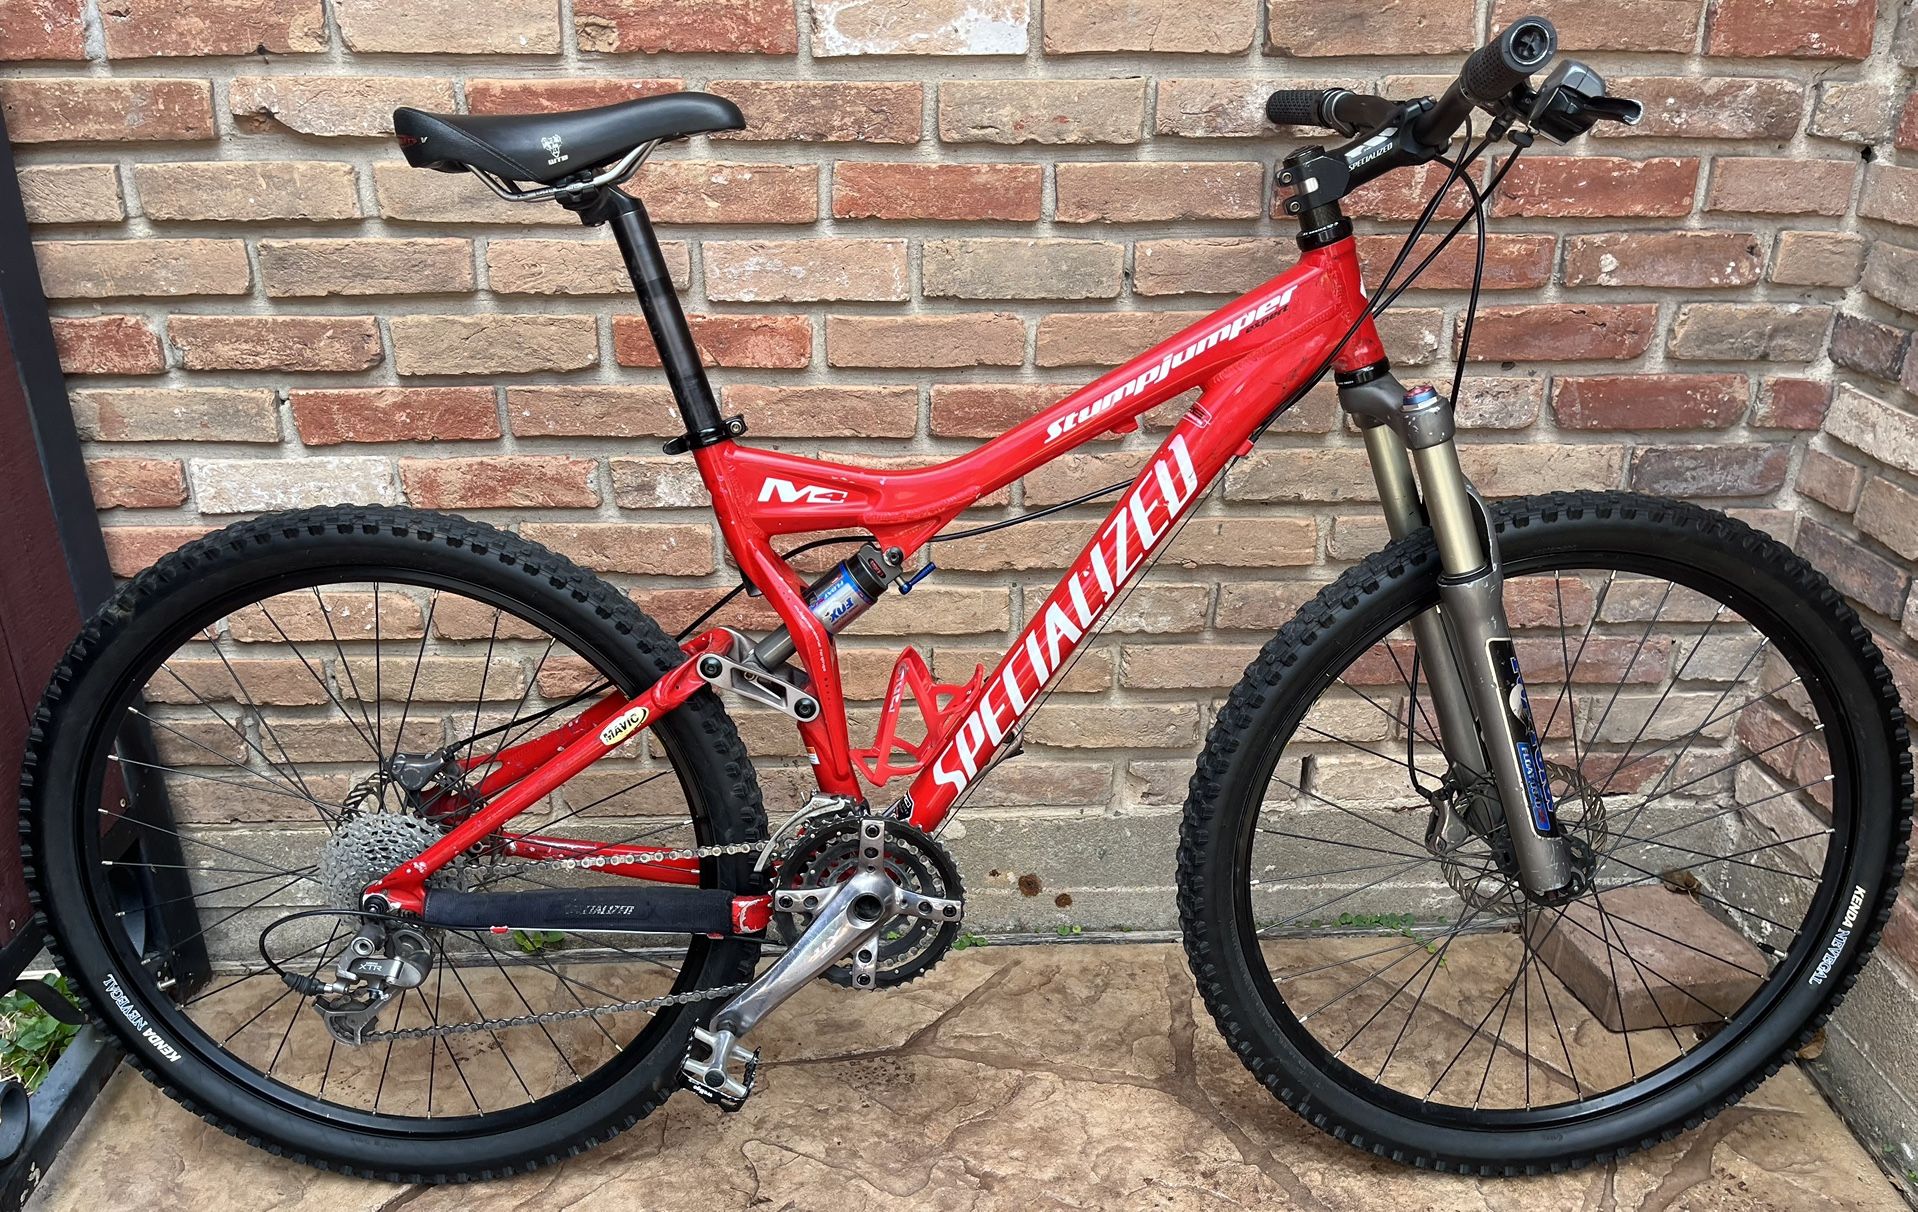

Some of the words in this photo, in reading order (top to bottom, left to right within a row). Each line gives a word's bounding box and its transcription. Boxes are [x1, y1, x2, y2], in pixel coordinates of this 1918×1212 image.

[548, 154, 569, 166] WTB
[1348, 142, 1393, 171] SPECIALIZED
[1246, 304, 1288, 334] expert
[1044, 285, 1297, 443] Stumpjumper
[830, 597, 854, 623] FOX
[933, 433, 1198, 803] SPECIALIZED
[603, 712, 640, 742] MAVIC
[1842, 885, 1866, 928] KENDA
[358, 963, 382, 971] XTR
[1808, 928, 1850, 985] NEVEGAL
[103, 973, 148, 1031] NEVEGAL
[142, 1027, 182, 1062] KENDA
